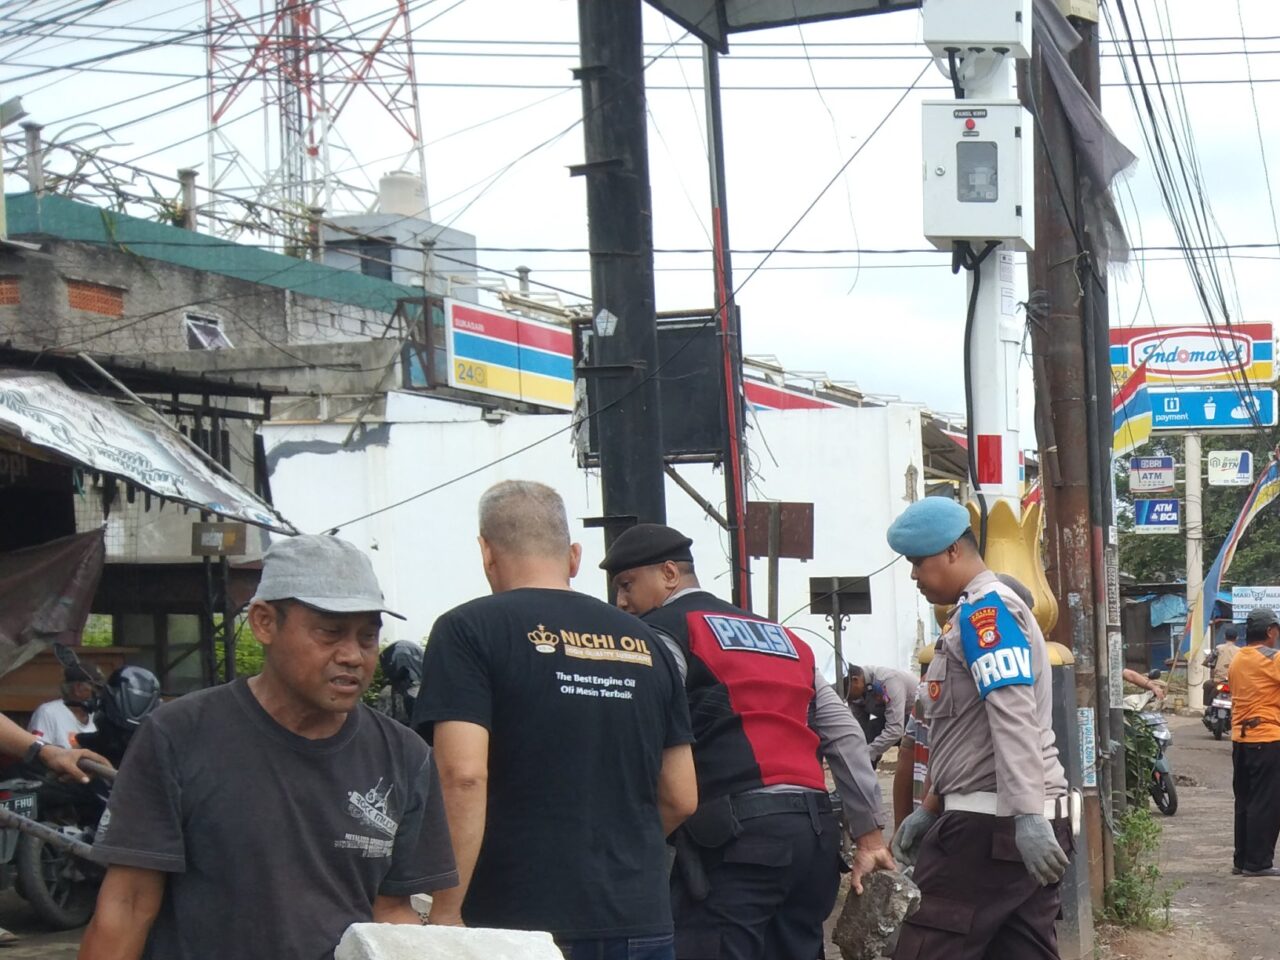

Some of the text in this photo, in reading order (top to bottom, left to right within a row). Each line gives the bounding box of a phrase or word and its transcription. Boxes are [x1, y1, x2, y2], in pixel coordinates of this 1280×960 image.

[1139, 345, 1244, 364] Indomaret
[457, 363, 474, 381] 24
[1115, 371, 1128, 381] 24
[1155, 412, 1189, 423] payment
[1142, 472, 1162, 480] ATM
[1154, 503, 1173, 512] ATM
[1160, 512, 1177, 521] BCA
[560, 629, 652, 655] NICHI OIL
[970, 647, 1031, 693] PROV
[556, 672, 635, 687] The Best Engine Oil
[576, 687, 599, 697] Mesin
[600, 689, 632, 699] Terbaik
